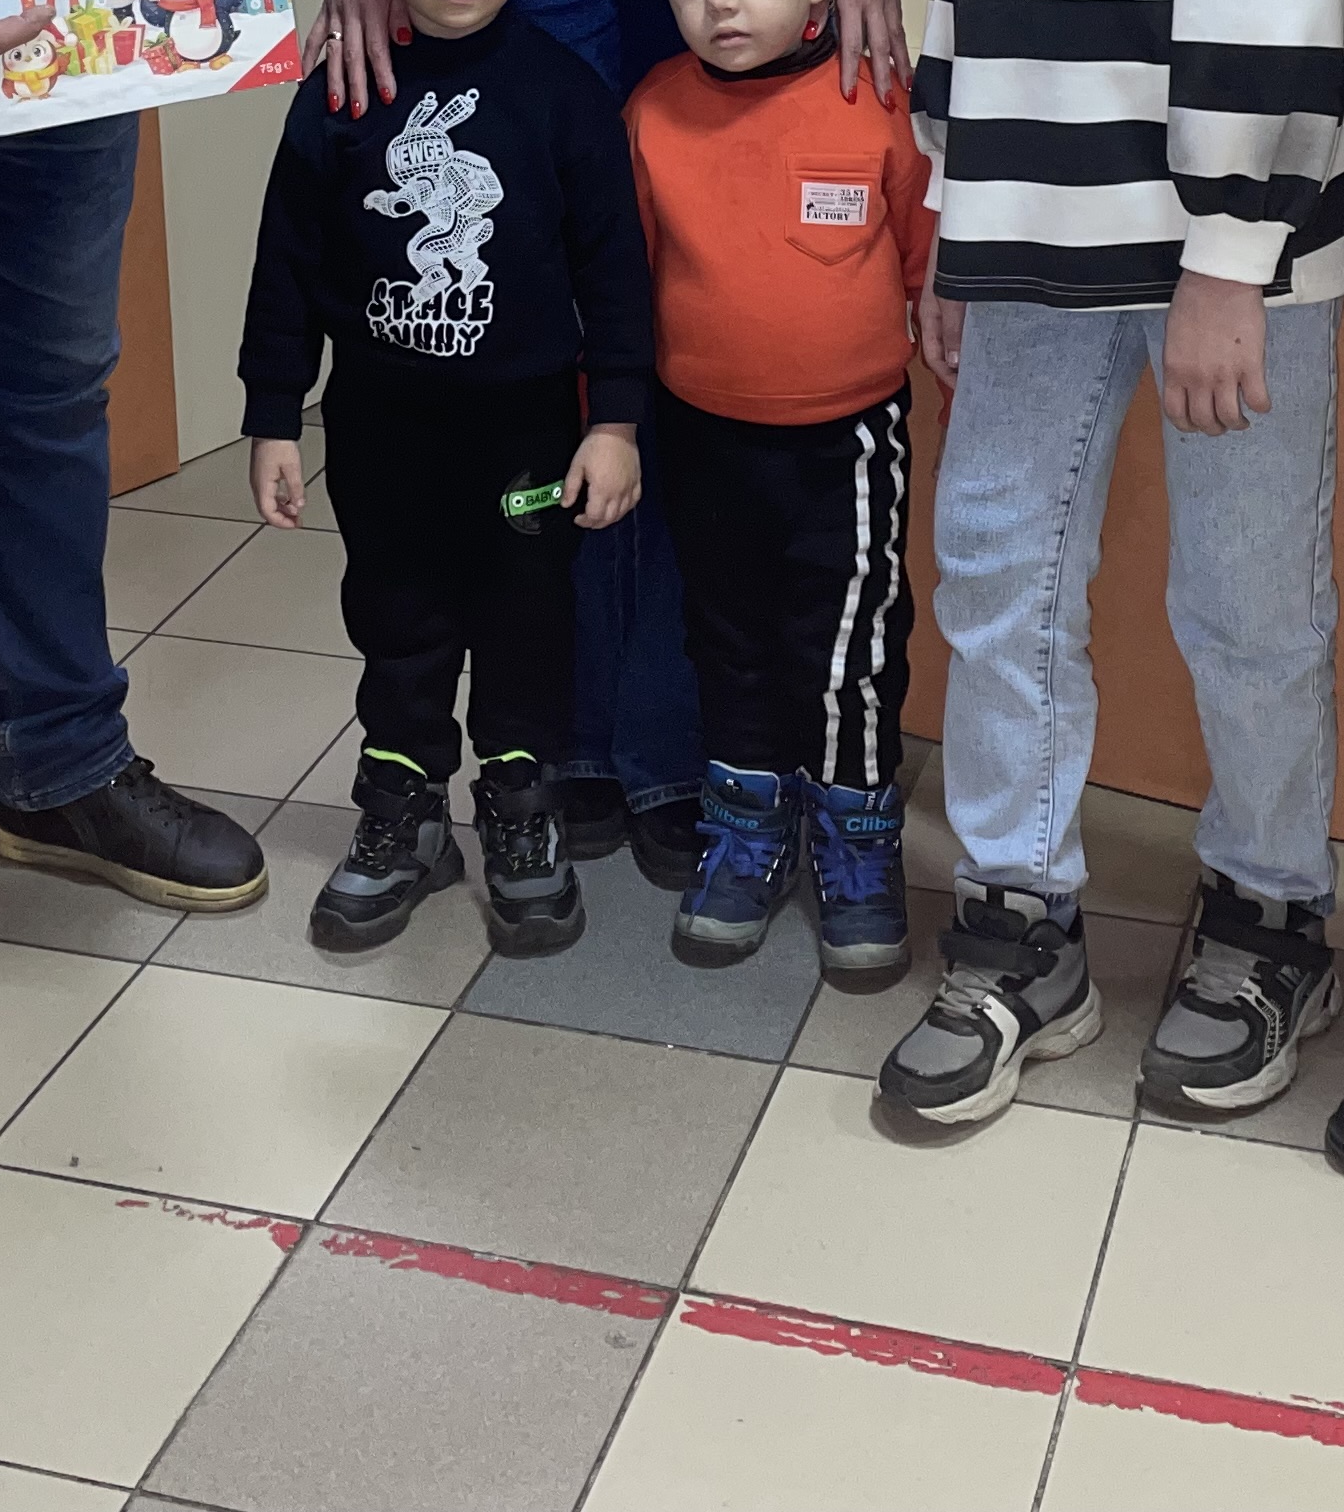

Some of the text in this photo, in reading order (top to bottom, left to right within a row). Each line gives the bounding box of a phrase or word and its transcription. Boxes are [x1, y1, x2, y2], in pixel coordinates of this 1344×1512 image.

[389, 140, 451, 169] NEWGEN
[806, 211, 850, 221] FACTORY
[366, 278, 494, 324] SPACE
[369, 317, 485, 356] BUNNY
[526, 489, 553, 506] BABY
[703, 798, 759, 830] Clibee
